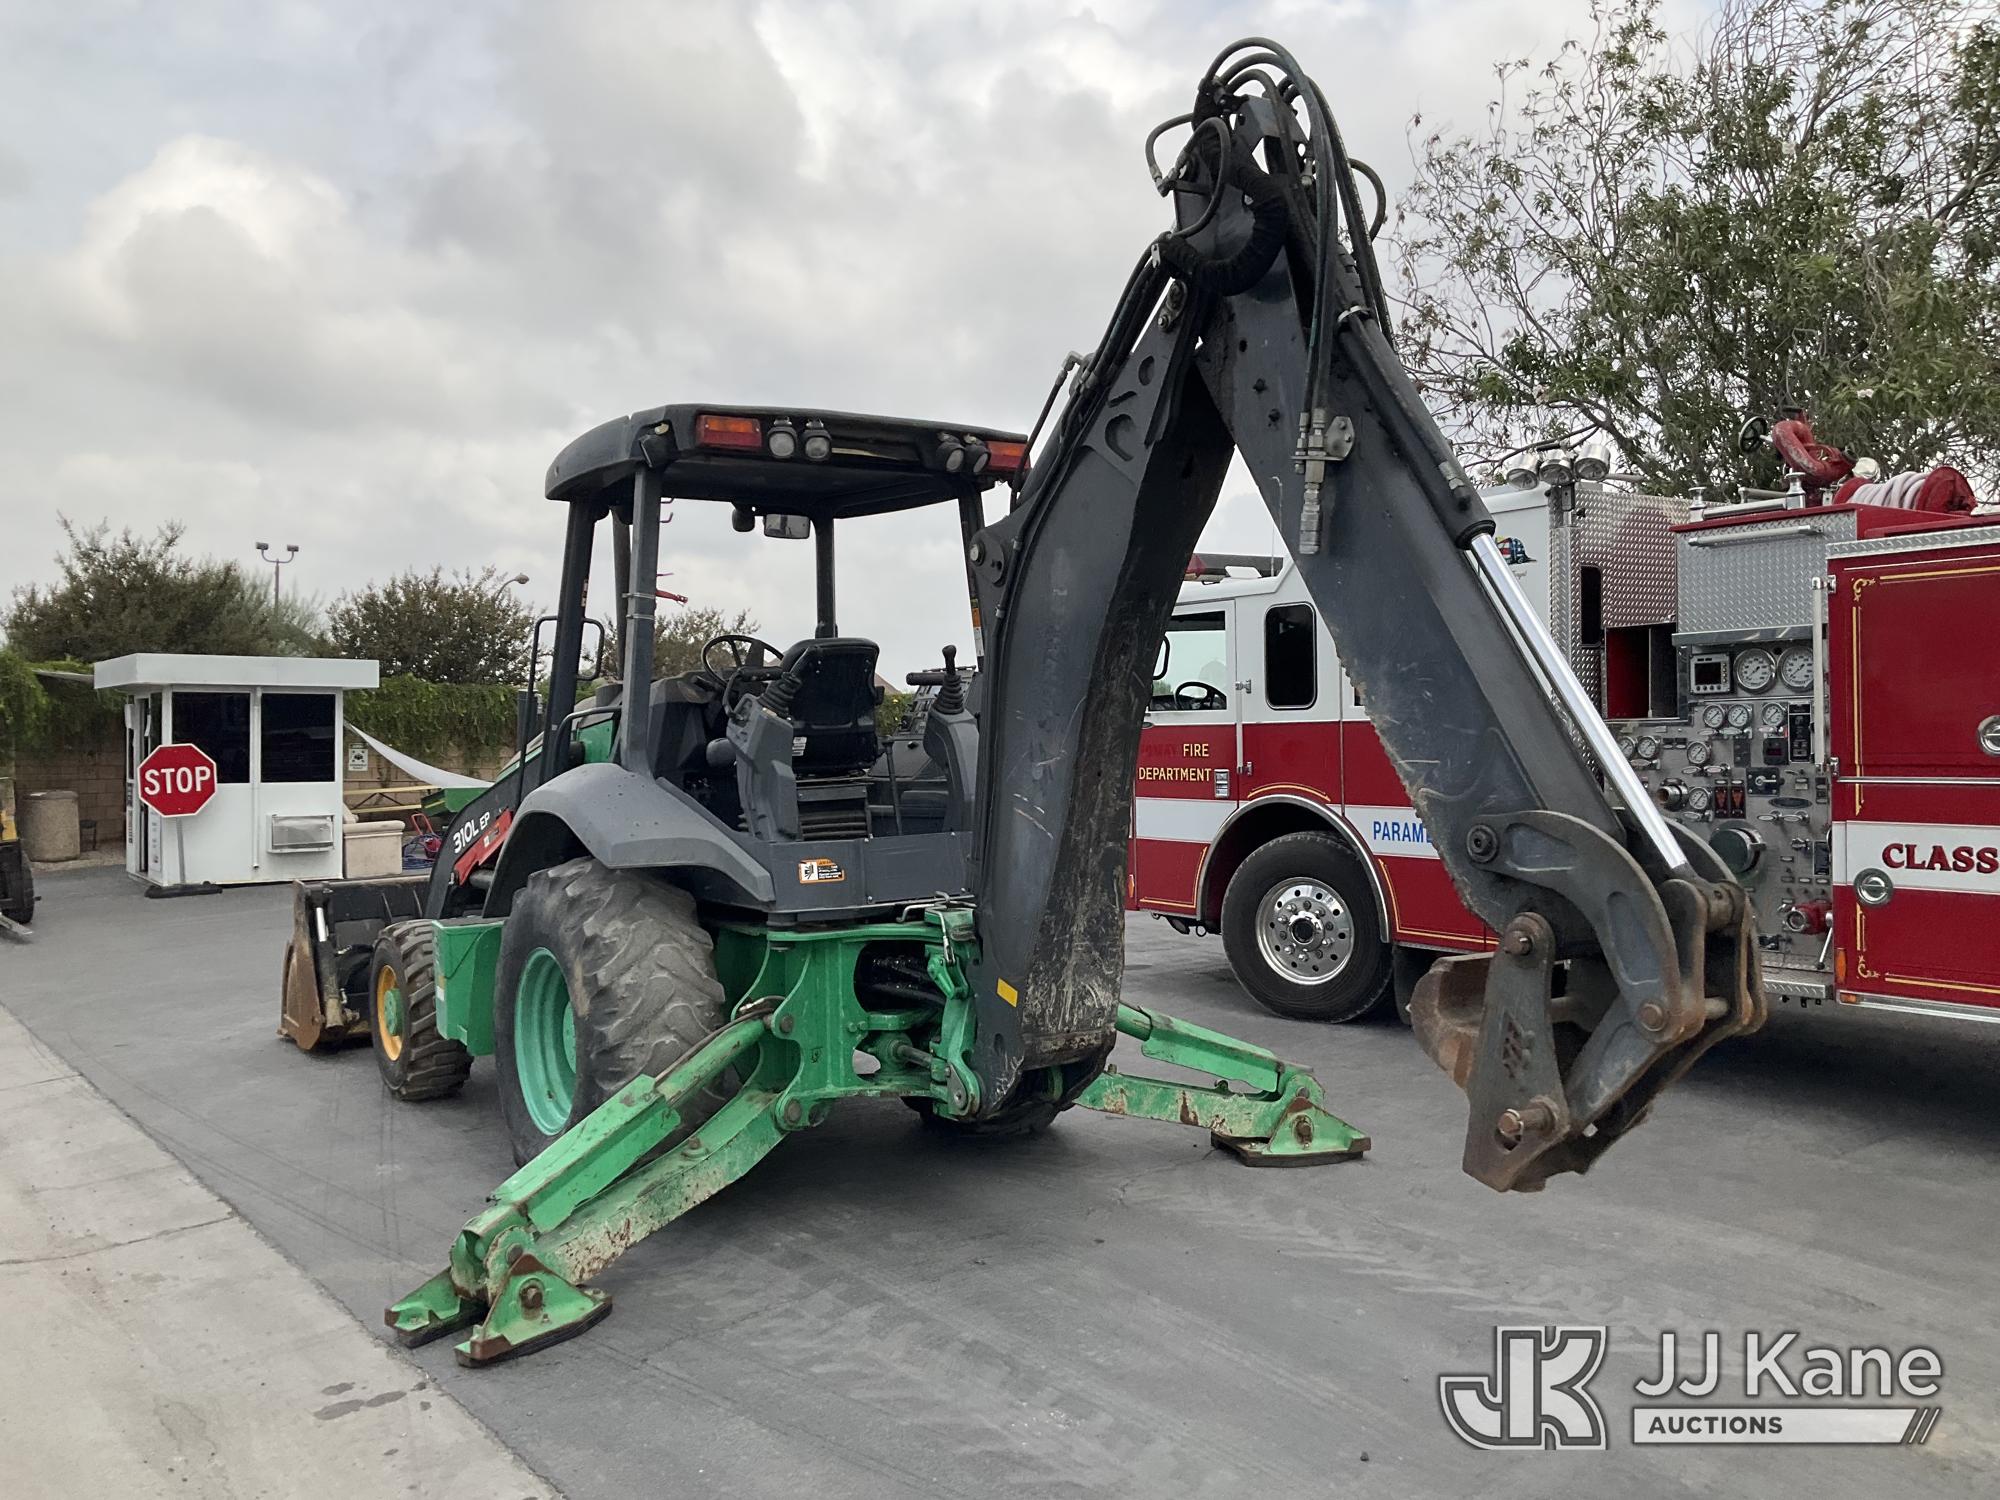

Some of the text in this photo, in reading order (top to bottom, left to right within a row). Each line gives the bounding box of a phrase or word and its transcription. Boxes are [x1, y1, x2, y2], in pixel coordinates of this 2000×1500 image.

[1183, 743, 1209, 757] FIRE
[144, 766, 211, 796] STOP
[1138, 767, 1212, 782] DEPARTMENT
[453, 812, 490, 853] 310L EP
[1882, 843, 1999, 874] CLASS
